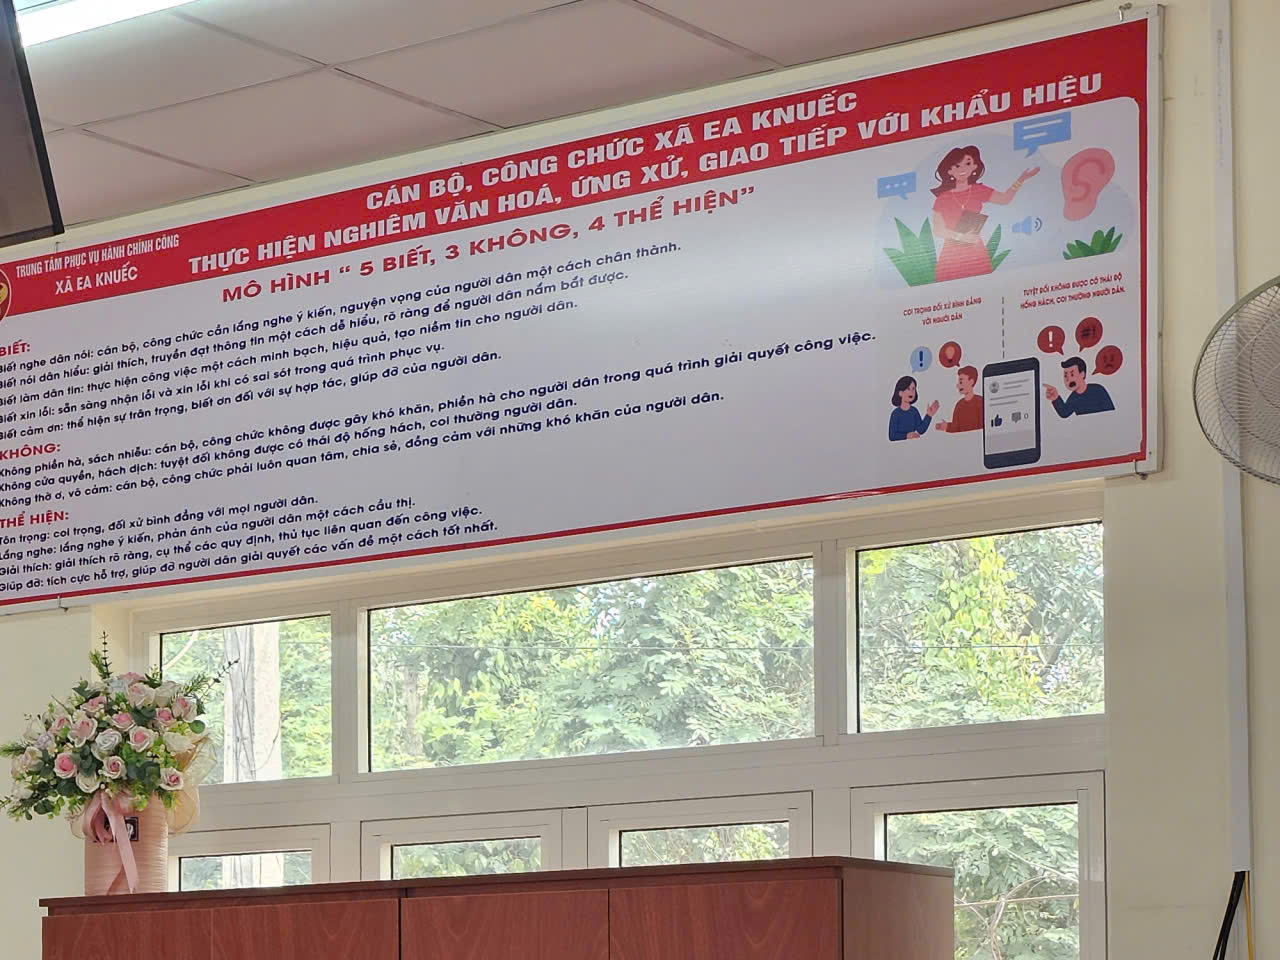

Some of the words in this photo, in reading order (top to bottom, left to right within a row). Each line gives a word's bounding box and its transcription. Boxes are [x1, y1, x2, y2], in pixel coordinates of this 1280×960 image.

[187, 247, 250, 274] THỰC
[257, 233, 316, 261] HIỆN
[323, 210, 426, 248] NGHIÊM
[434, 198, 489, 225] VĂN
[497, 182, 562, 213] HOÁ,
[571, 170, 631, 198] ỨNG
[640, 154, 689, 185] XỬ,
[698, 141, 769, 172] GIAO
[778, 123, 847, 156] TIẾP
[857, 111, 909, 140] VỚI
[920, 88, 1011, 128] KHẨU
[1022, 72, 1101, 107] HIỆU
[366, 183, 420, 210] CÁN
[428, 171, 473, 198] BỘ,
[481, 155, 558, 186] CÔNG
[567, 136, 644, 169] CHỨC
[653, 122, 694, 151] XÃ
[703, 116, 742, 141] EA
[751, 91, 857, 131] KNUẾC
[222, 279, 262, 303] MÔ
[270, 269, 330, 294] HÌNH
[359, 260, 374, 276] 5
[382, 244, 435, 272] BIẾT,
[444, 244, 460, 260] 3
[469, 223, 578, 256] KHÔNG,
[587, 215, 605, 231] 4
[613, 203, 662, 227] THỂ
[54, 275, 73, 295] XÃ
[76, 274, 92, 291] EA
[95, 265, 138, 287] KNUẾC
[0, 442, 61, 461] KHÔNG:
[18, 532, 50, 544] trọng:
[52, 527, 70, 538] coi
[72, 525, 105, 537] trọng,
[107, 518, 126, 531] đối
[128, 516, 144, 528] xử
[146, 514, 171, 526] bình
[173, 508, 204, 522] đẳng
[207, 506, 225, 517] với
[228, 503, 250, 516] mọi
[253, 497, 287, 513] người
[290, 494, 318, 507] dân.
[29, 509, 69, 525] HIỆN:
